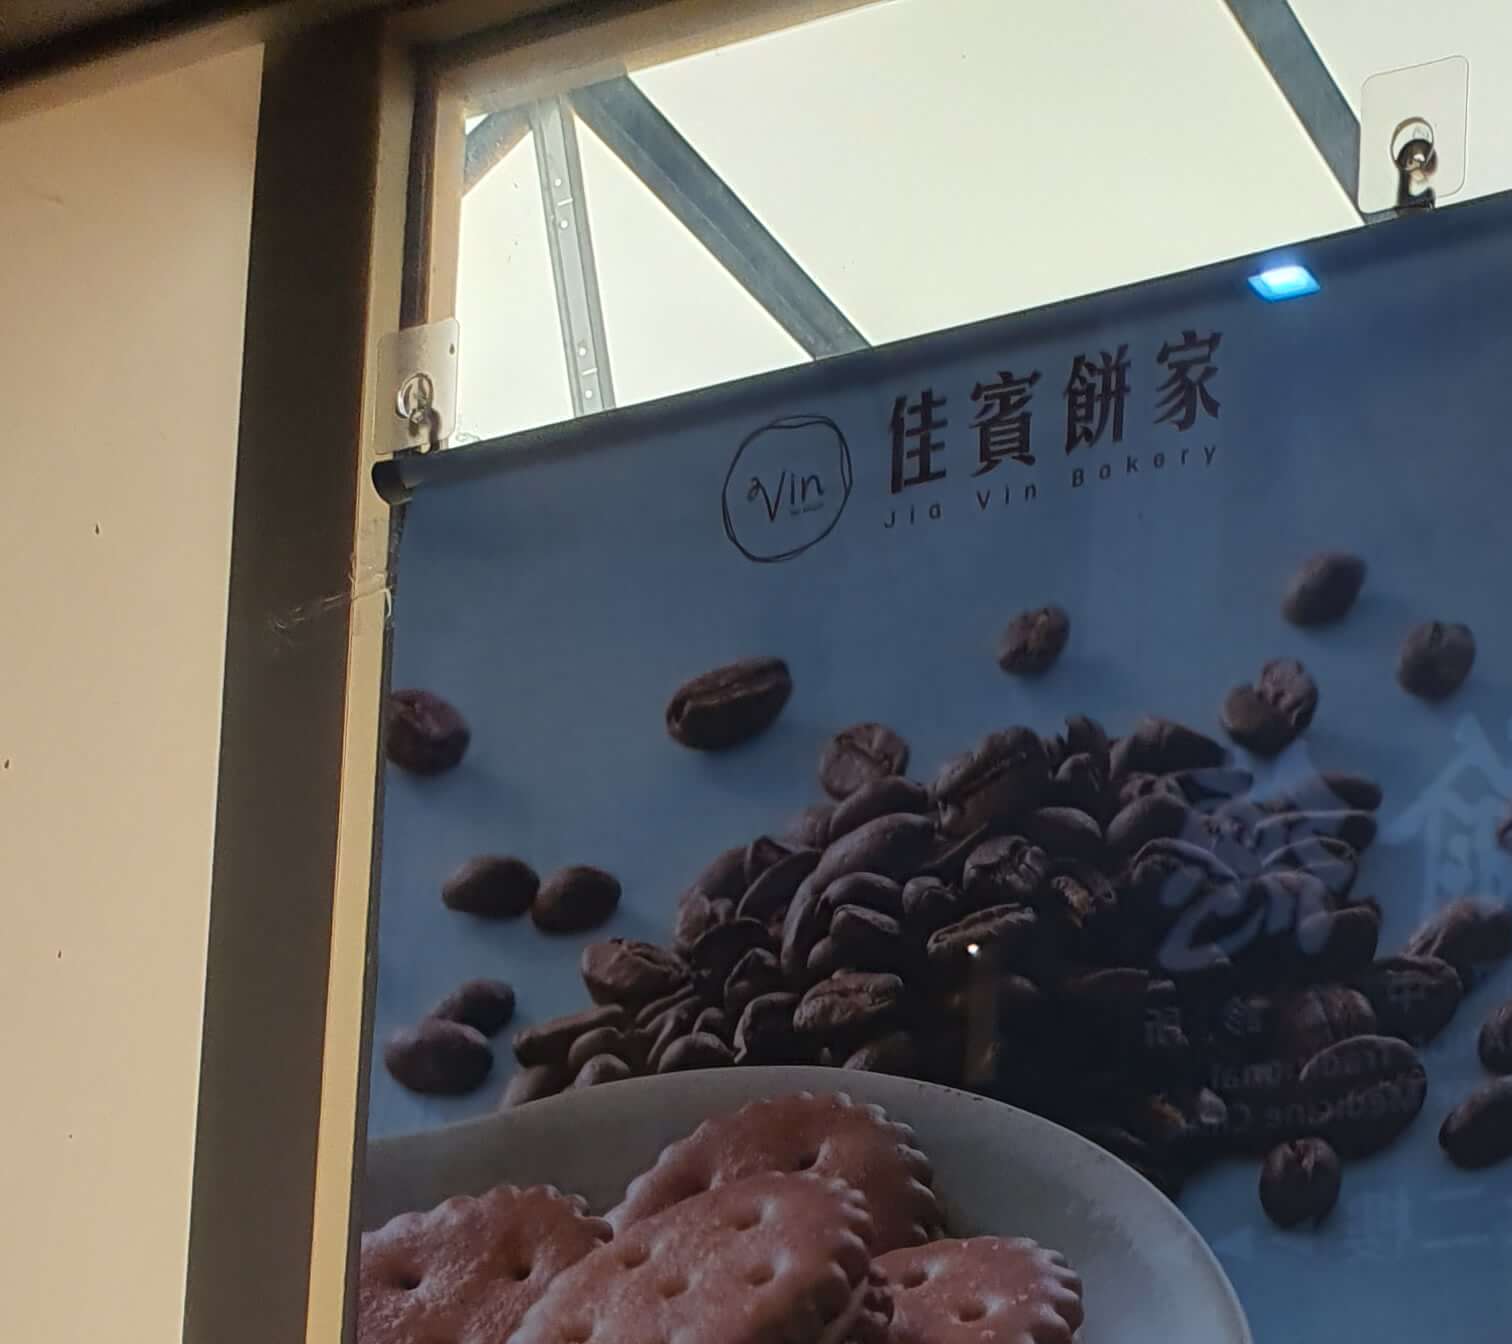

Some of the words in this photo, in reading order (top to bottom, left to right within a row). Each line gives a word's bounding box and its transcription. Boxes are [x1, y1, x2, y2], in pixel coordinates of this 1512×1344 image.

[889, 329, 1223, 494] 佳賓餅家
[884, 503, 942, 529] Jia
[976, 483, 1037, 510] Vin
[1072, 444, 1217, 488] Bakery
